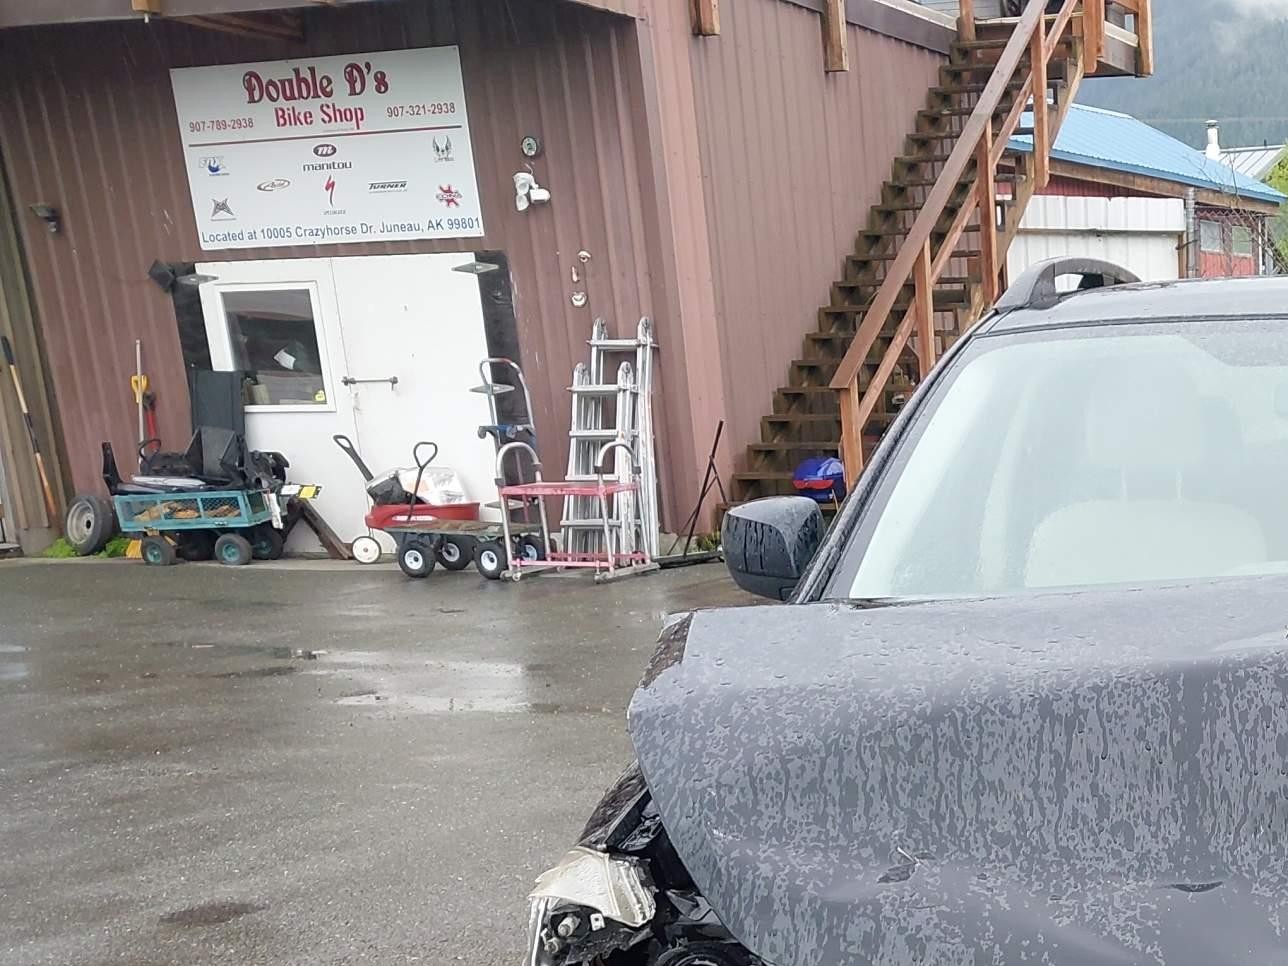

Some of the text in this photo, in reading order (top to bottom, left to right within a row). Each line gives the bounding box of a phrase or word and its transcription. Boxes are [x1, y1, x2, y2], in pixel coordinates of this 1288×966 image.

[242, 61, 389, 104] Double D's
[274, 103, 364, 130] Bike Shop
[386, 102, 456, 118] 907-321-2938
[189, 117, 255, 132] 907-789-2938
[303, 161, 352, 172] manitou
[201, 217, 480, 243] Located at 10005 Crazyhorse Dr. Juneau, AK 99801
